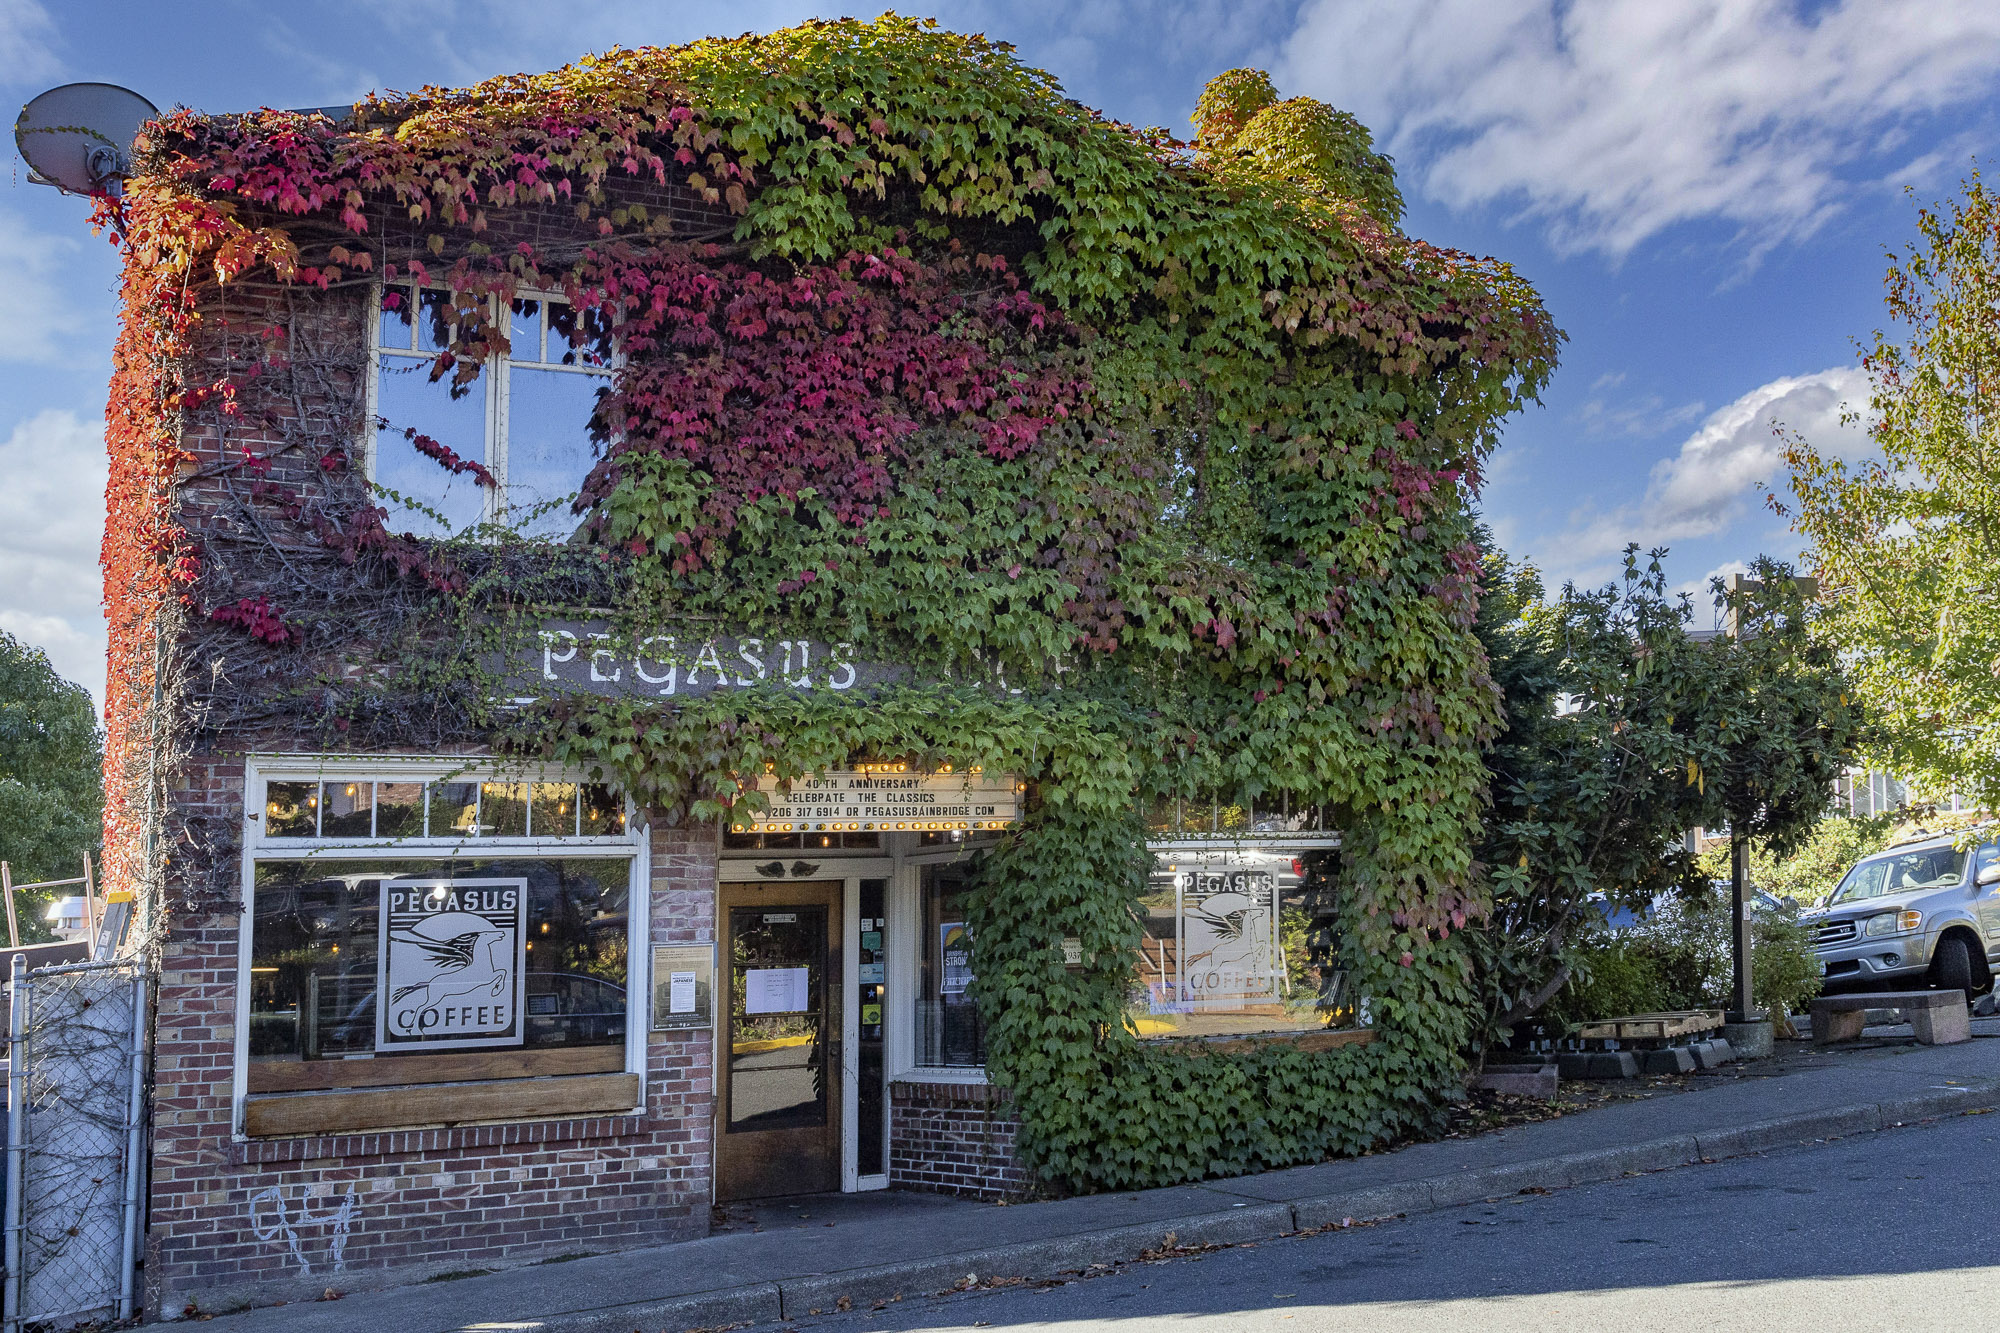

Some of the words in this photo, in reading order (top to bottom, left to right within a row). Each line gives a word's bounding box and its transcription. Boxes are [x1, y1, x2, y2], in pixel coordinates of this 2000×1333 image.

[538, 630, 857, 695] PEGASUS
[848, 779, 919, 789] ANNIVERSARY
[858, 793, 877, 803] THE
[886, 793, 935, 803] CLASSICS
[772, 807, 792, 817] 206
[796, 807, 812, 817] 317
[816, 806, 840, 817] 6914
[846, 807, 859, 817] OR
[865, 806, 970, 817] PEGASUSBAINBRIDGE
[975, 806, 995, 816] COM
[1183, 875, 1273, 893] PEGASUS
[390, 890, 517, 913] PEGASUS
[945, 957, 969, 966] STRON
[1190, 971, 1265, 989] COFFEE
[397, 1006, 505, 1029] COFFEE
